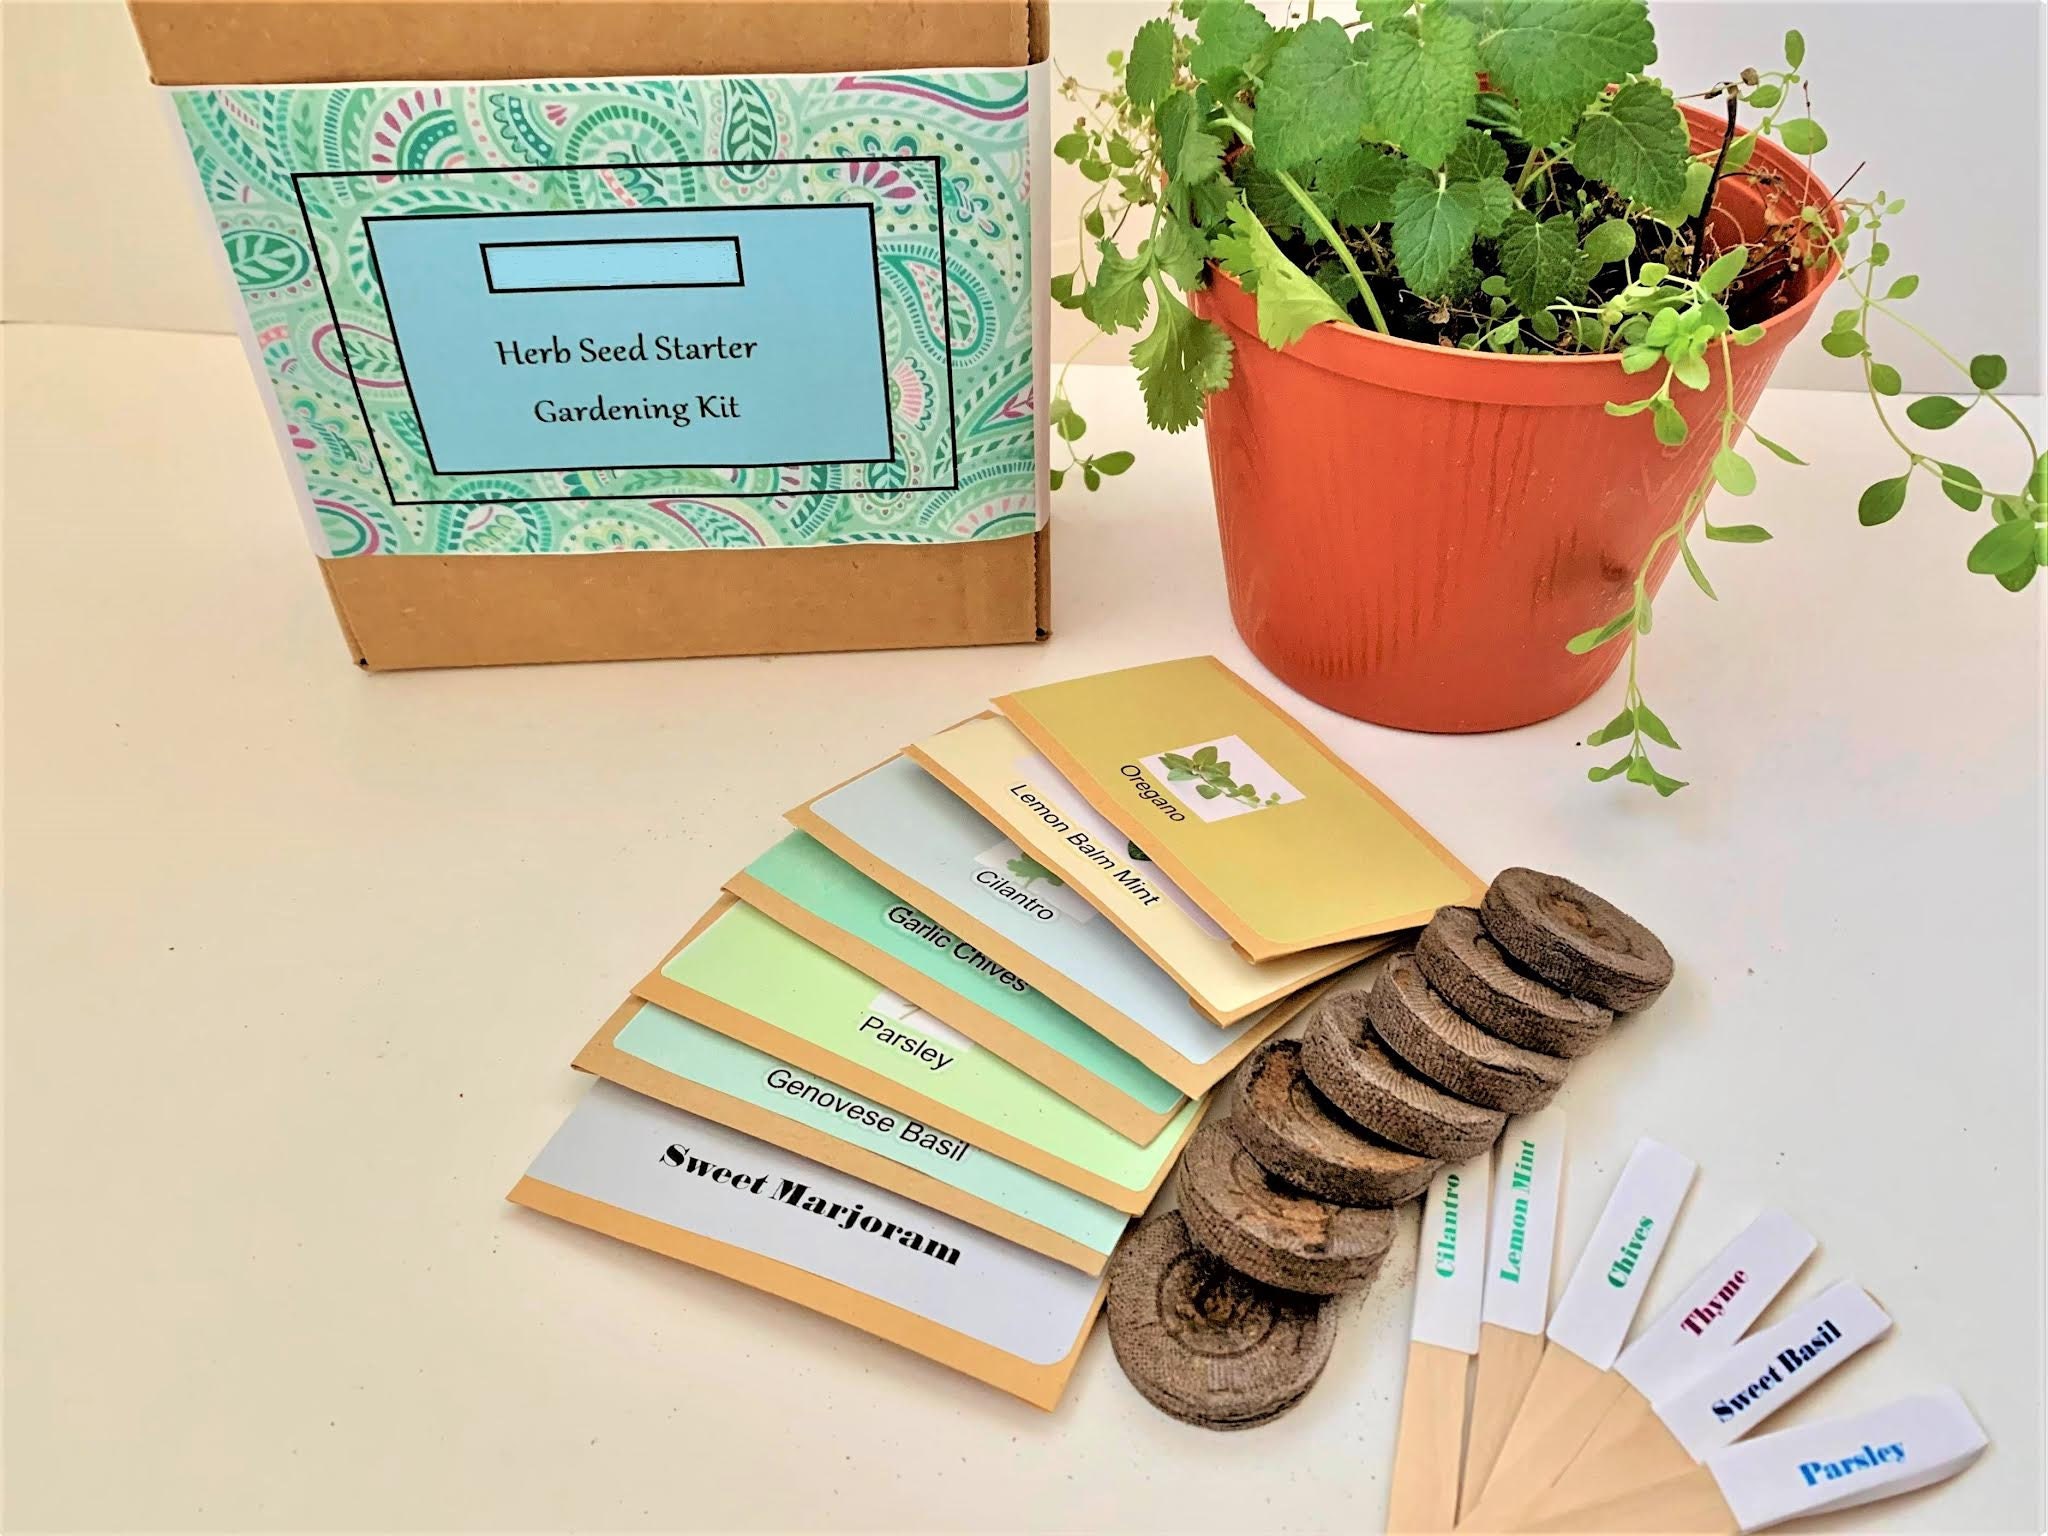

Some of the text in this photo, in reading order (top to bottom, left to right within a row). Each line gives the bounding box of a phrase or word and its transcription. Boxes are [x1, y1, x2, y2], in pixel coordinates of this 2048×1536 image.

[495, 332, 758, 365] Herb Seed Starter
[534, 394, 741, 427] Gardening Kit
[1119, 763, 1186, 823] Oregano
[1009, 783, 1160, 907] Lemon Balm Mint
[975, 869, 1055, 921] Cilantro
[887, 905, 1029, 993] Garlic Chives
[859, 1015, 955, 1072] Parsley
[766, 1068, 970, 1162] Genovese Basil
[658, 1143, 962, 1266] Sweet Marjoram
[1433, 1174, 1461, 1279] Cilantro
[1499, 1140, 1537, 1284] Lemon Mint
[1607, 1215, 1655, 1290] Chives
[1680, 1266, 1750, 1338] Thyme
[1710, 1320, 1842, 1423] Sweet Basil
[1798, 1440, 1907, 1487] Parsley
